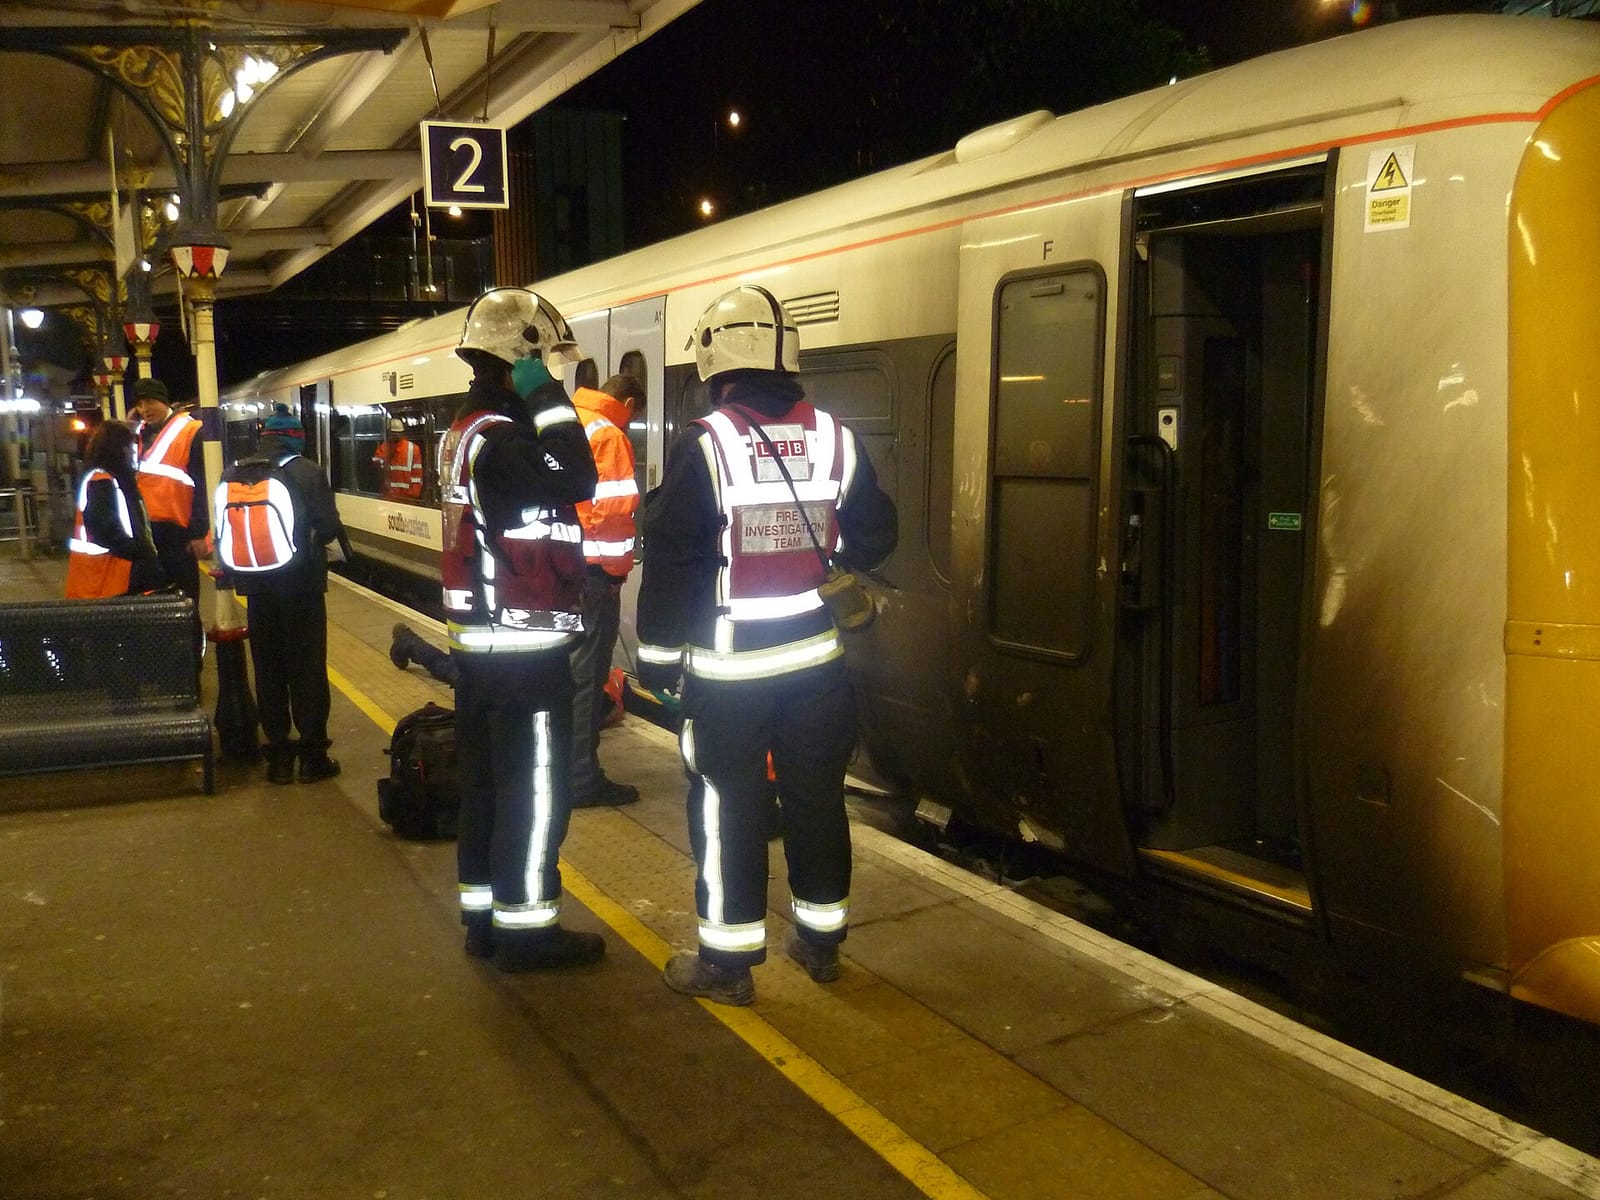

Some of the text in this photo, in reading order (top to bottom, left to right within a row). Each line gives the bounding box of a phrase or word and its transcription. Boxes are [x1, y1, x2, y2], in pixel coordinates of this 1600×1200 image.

[449, 137, 485, 193] 2
[1372, 199, 1400, 209] Danger
[1043, 240, 1054, 260] F
[776, 511, 799, 522] FIRE
[745, 522, 825, 537] INVESTIGATION
[773, 537, 801, 549] TEAM
